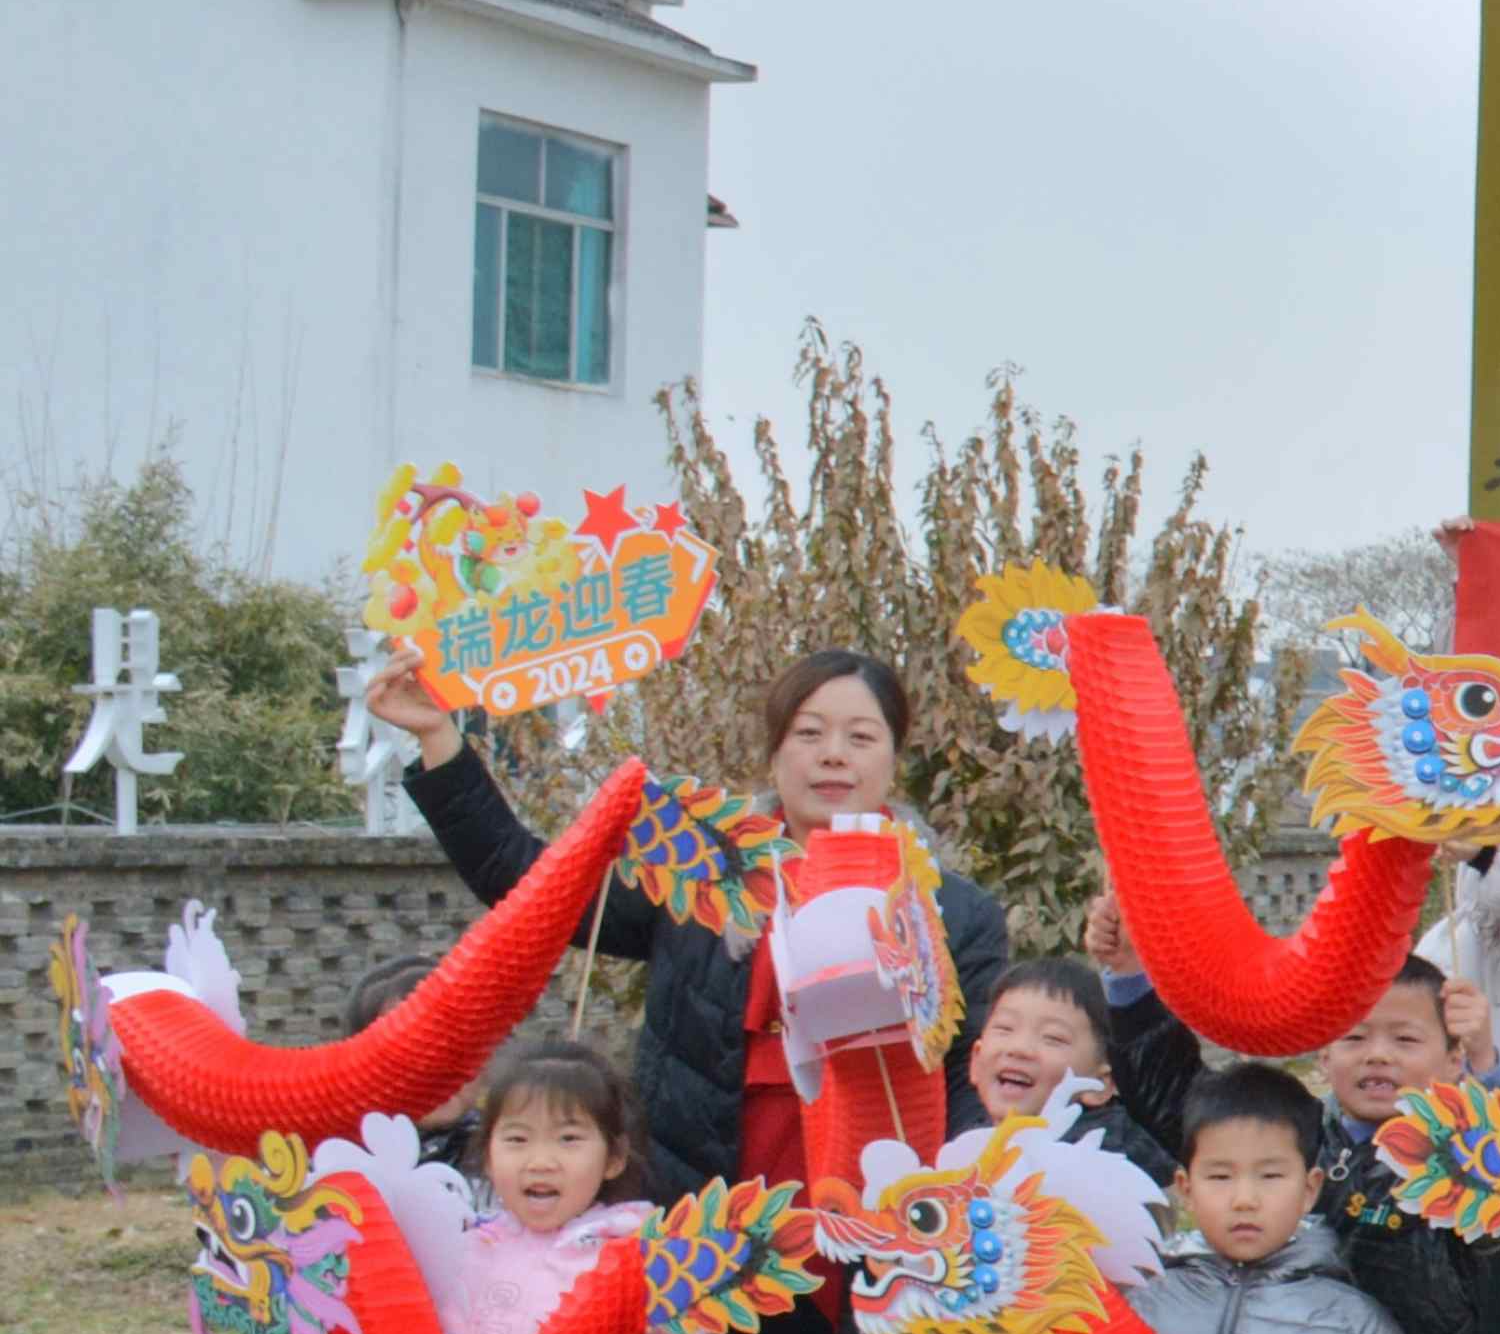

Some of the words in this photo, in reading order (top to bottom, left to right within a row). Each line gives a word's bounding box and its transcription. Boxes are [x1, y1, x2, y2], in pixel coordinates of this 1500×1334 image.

[437, 554, 676, 674] 瑞龙迎春
[528, 648, 613, 705] 2024
